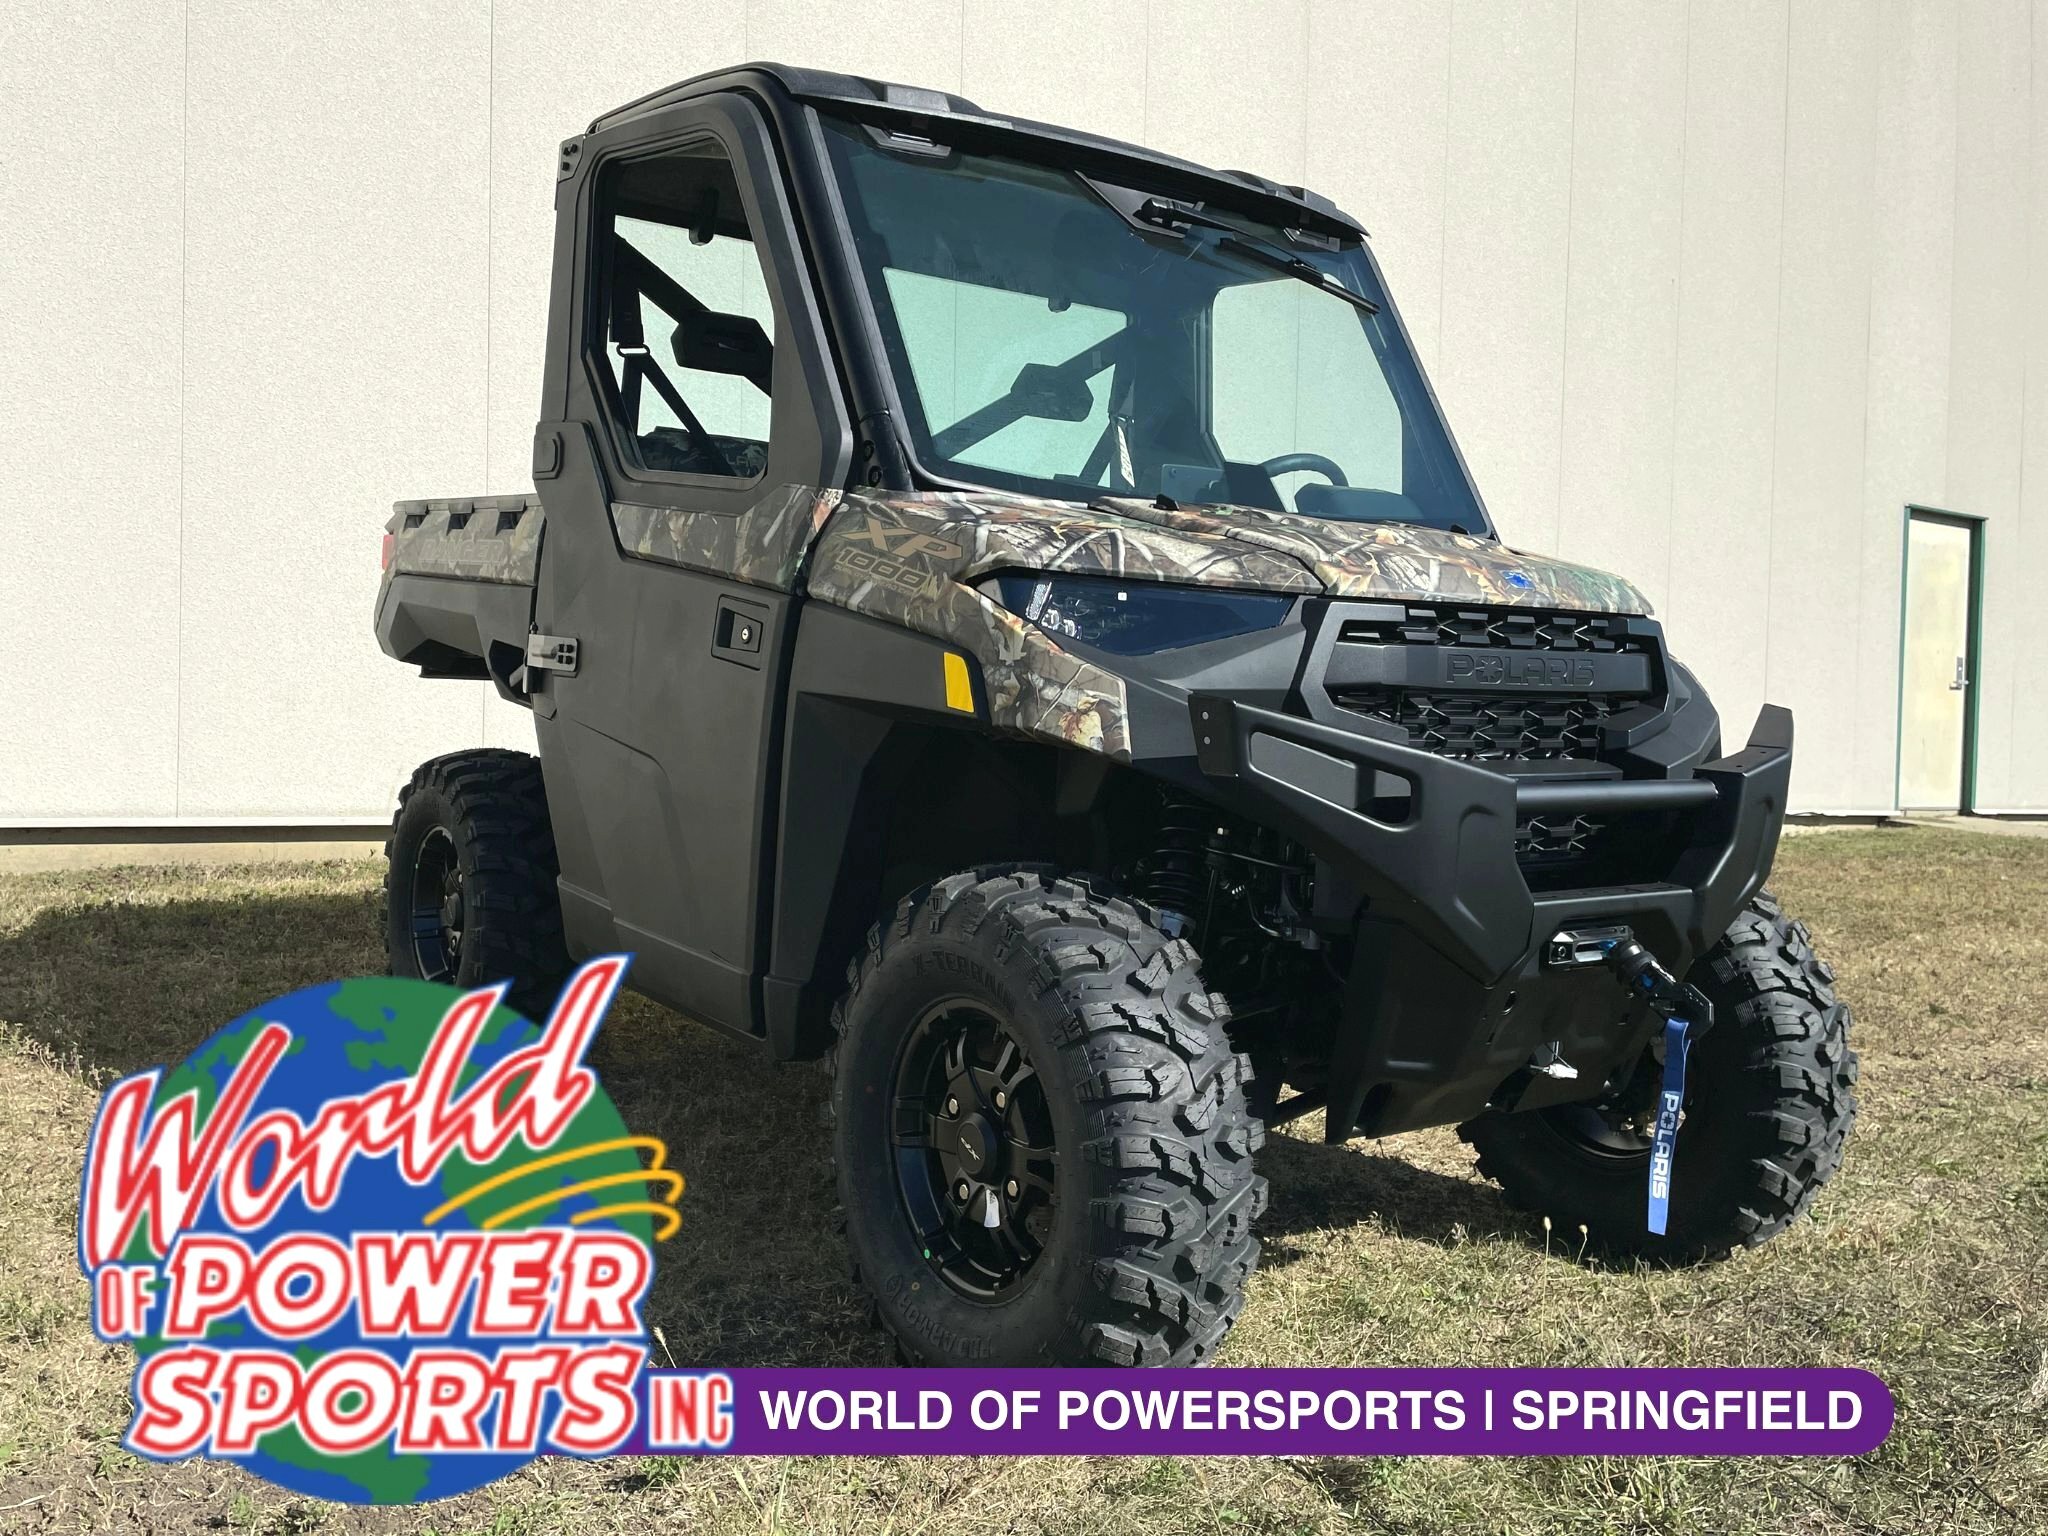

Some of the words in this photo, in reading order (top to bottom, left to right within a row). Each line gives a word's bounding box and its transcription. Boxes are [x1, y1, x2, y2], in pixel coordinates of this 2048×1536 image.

[834, 516, 963, 560] XP
[836, 547, 931, 590] 1000
[1446, 653, 1595, 687] POLARIS
[1652, 1093, 1680, 1199] POLARIS
